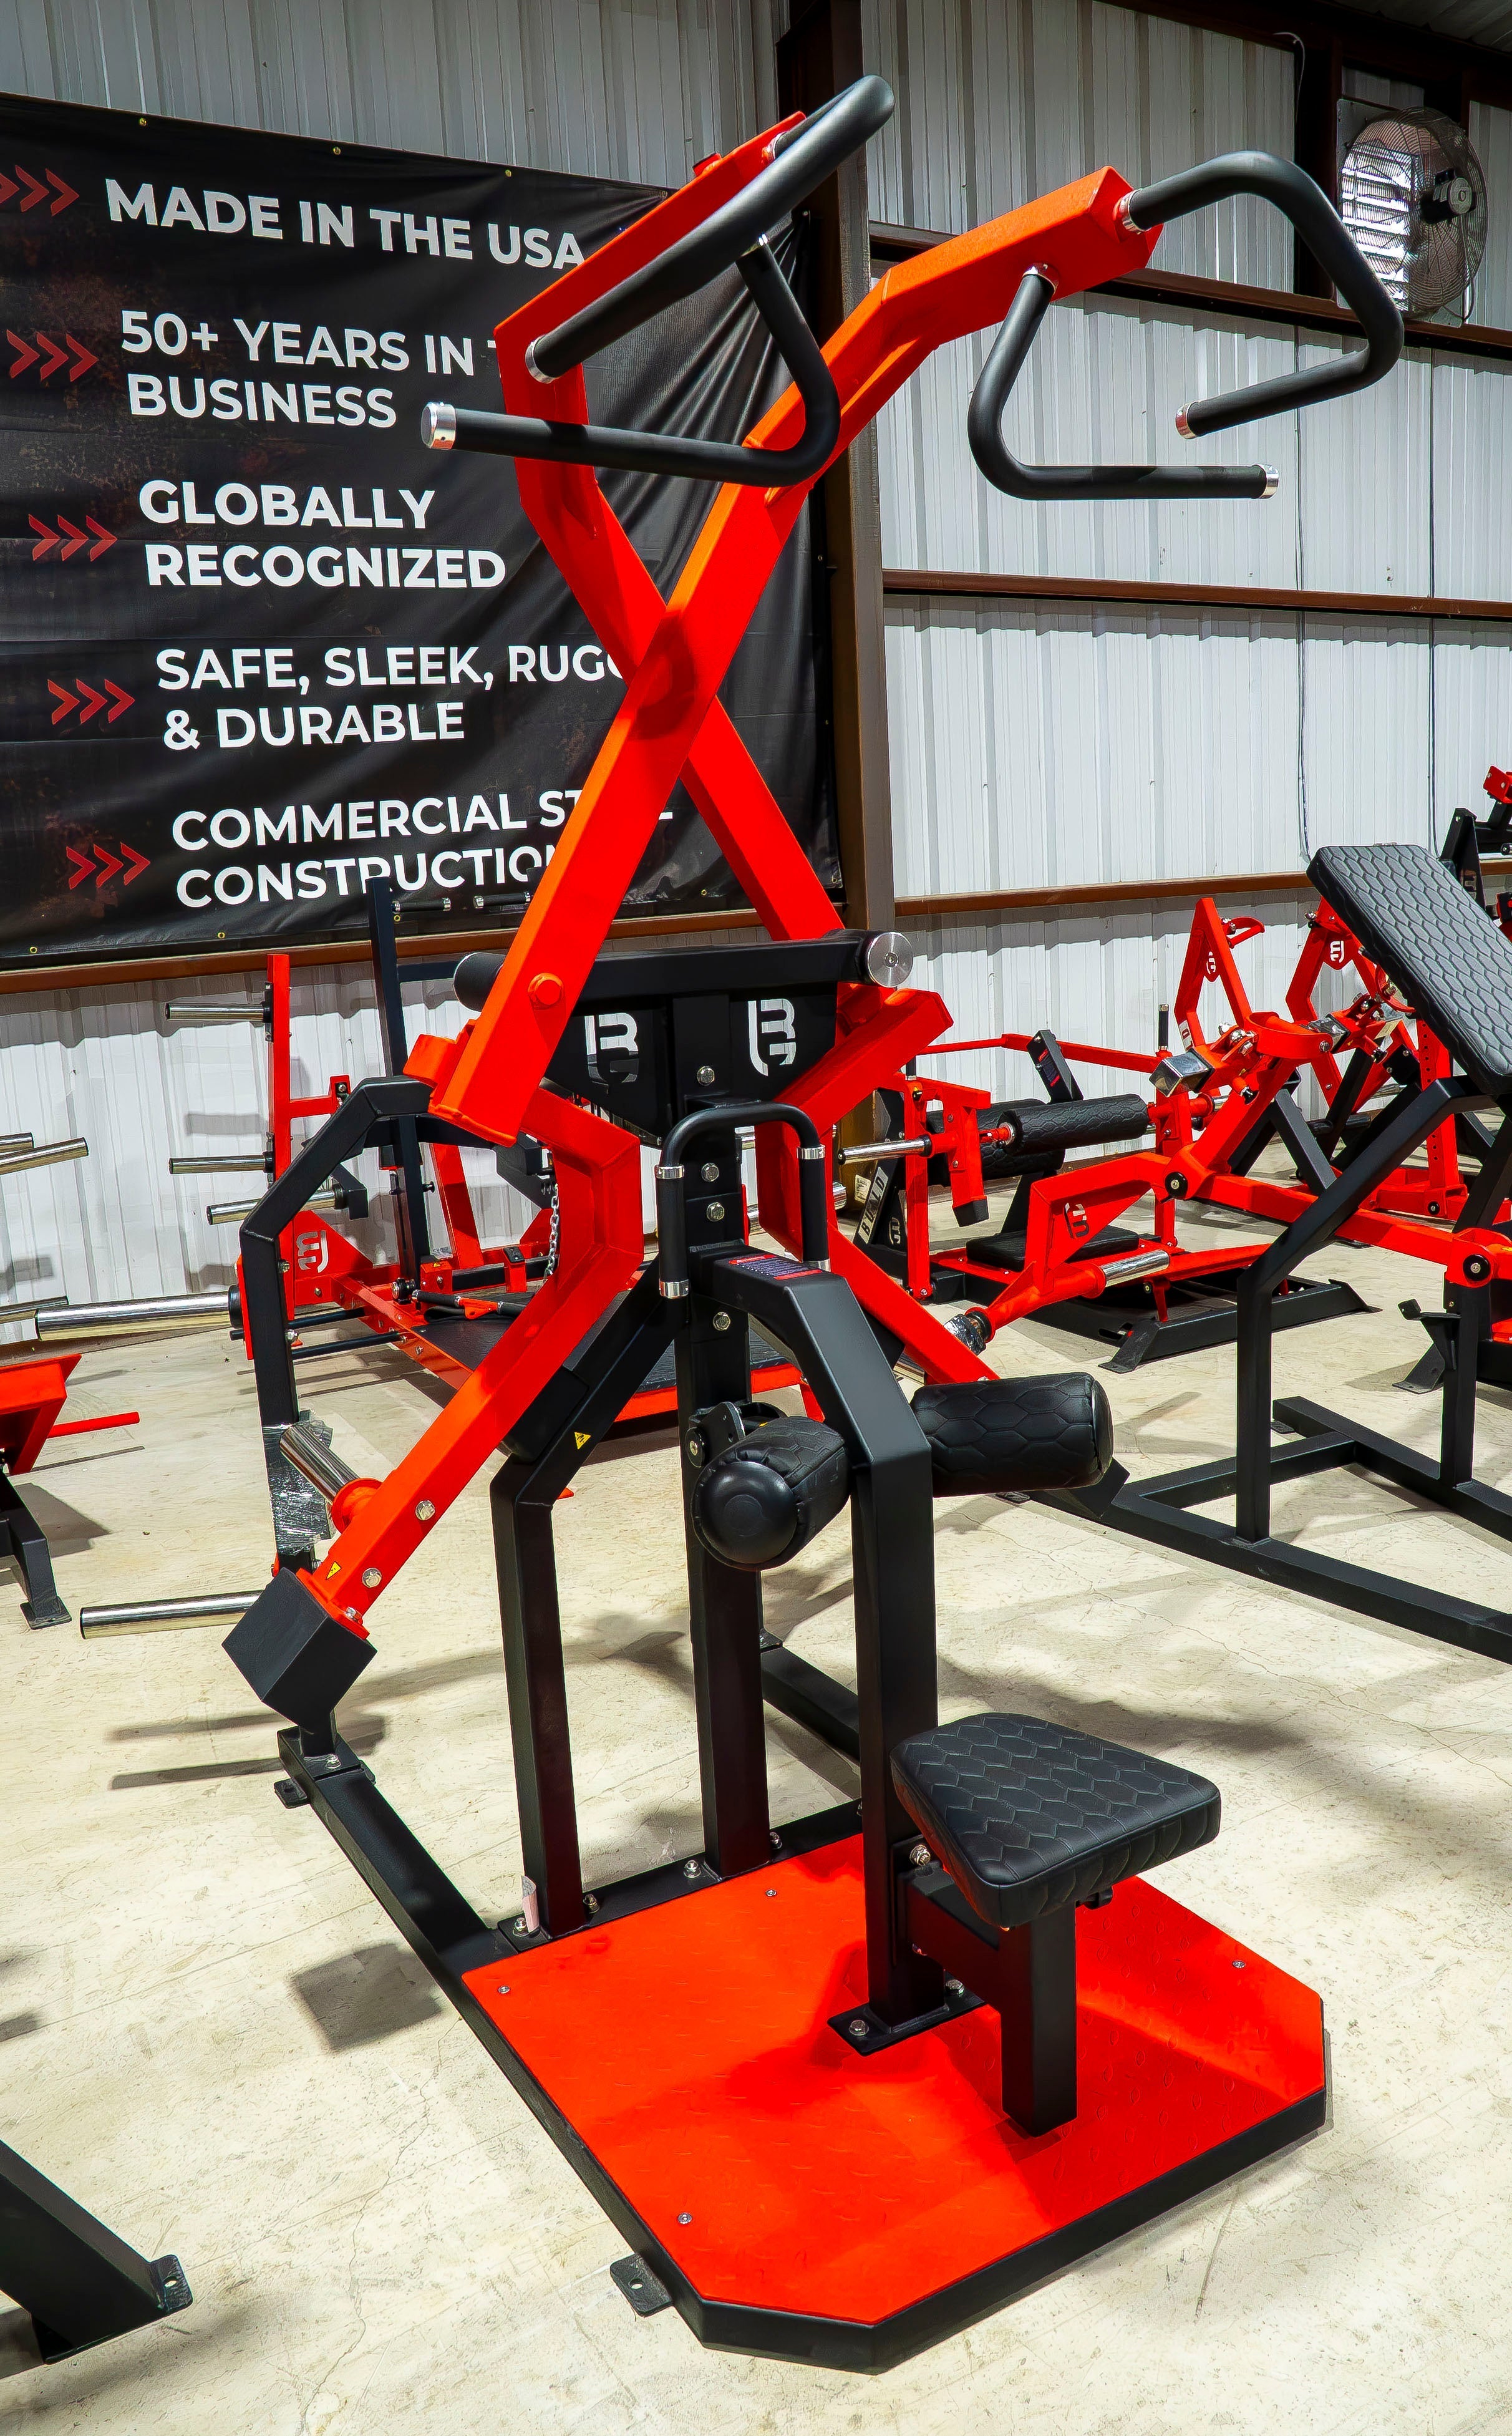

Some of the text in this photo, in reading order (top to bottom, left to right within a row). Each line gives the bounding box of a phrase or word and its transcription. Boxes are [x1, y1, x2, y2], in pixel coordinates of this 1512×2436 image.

[105, 179, 585, 269] MADE IN THE USA
[121, 311, 474, 376] 50+ YEARS IN
[128, 374, 397, 429] BUSINESS
[139, 480, 435, 530] GLOBALLY
[145, 544, 506, 588] RECOGNIZED
[156, 648, 311, 696] SAFE,
[324, 646, 493, 691] SLEEK,
[164, 702, 465, 750] & DURABLE
[172, 793, 528, 851] COMMERCIAL
